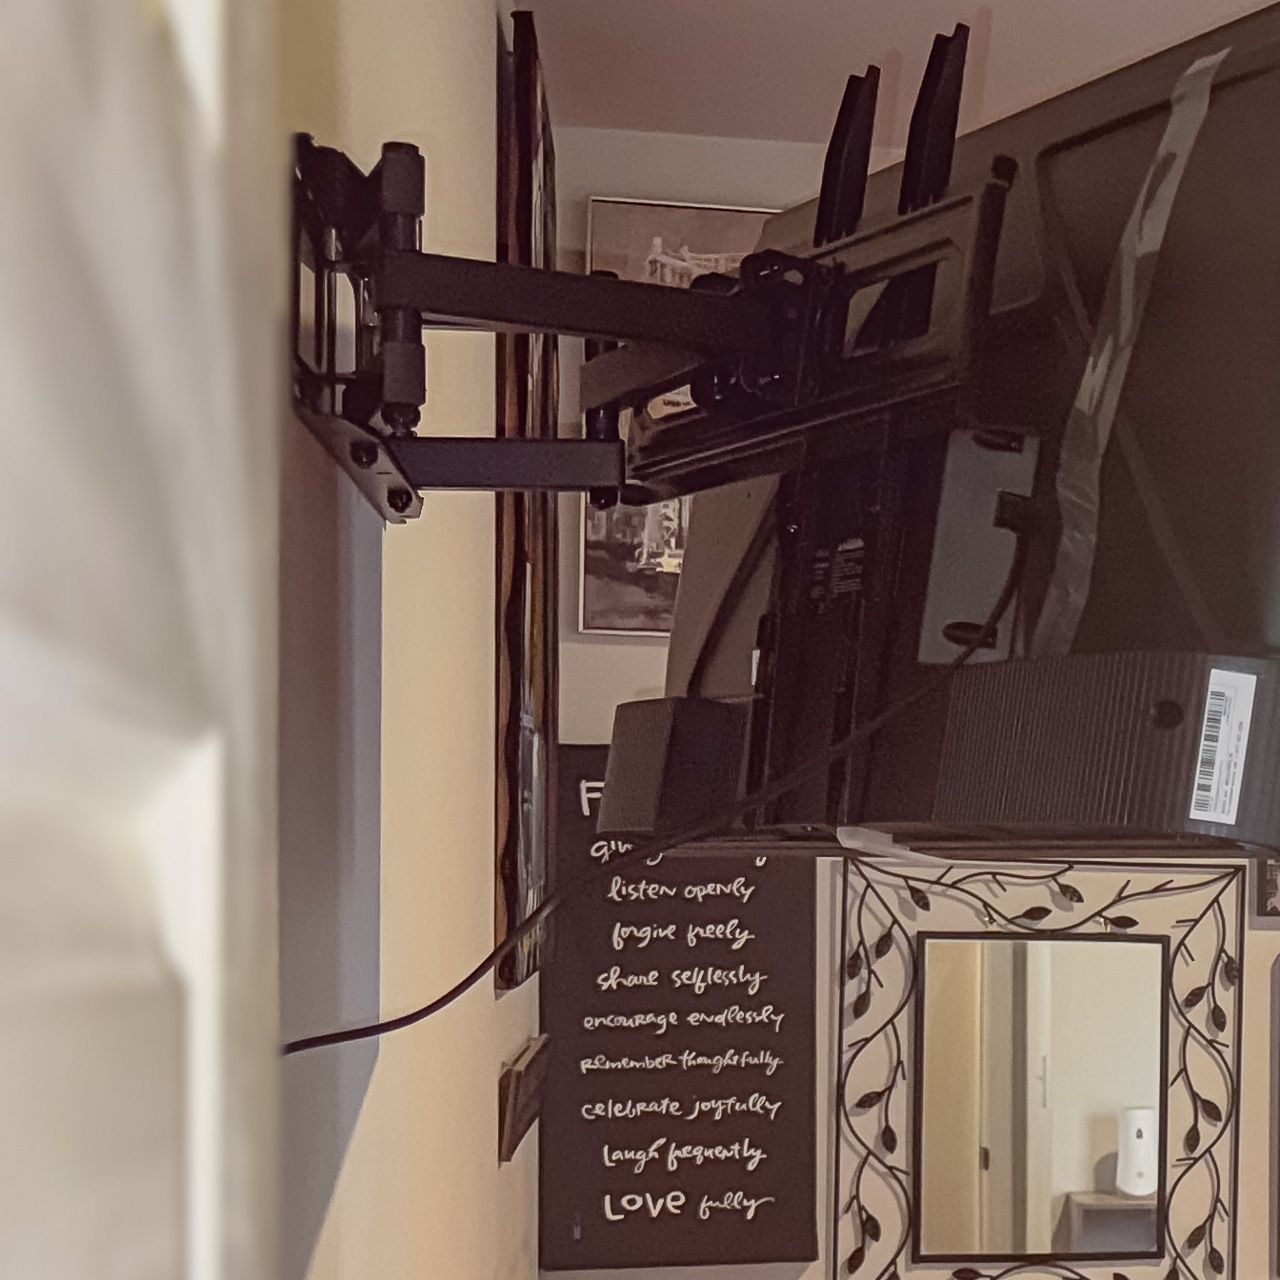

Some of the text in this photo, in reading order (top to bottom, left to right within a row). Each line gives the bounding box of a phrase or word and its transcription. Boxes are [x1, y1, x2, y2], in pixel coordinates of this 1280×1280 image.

[608, 876, 755, 903] listen openly
[612, 919, 756, 950] forgive freely
[597, 966, 659, 990] share
[584, 1005, 785, 1034] encourage endlessly
[581, 1093, 782, 1120] celebrate joyfully
[667, 1138, 767, 1171] frequently
[700, 1192, 775, 1220] fully
